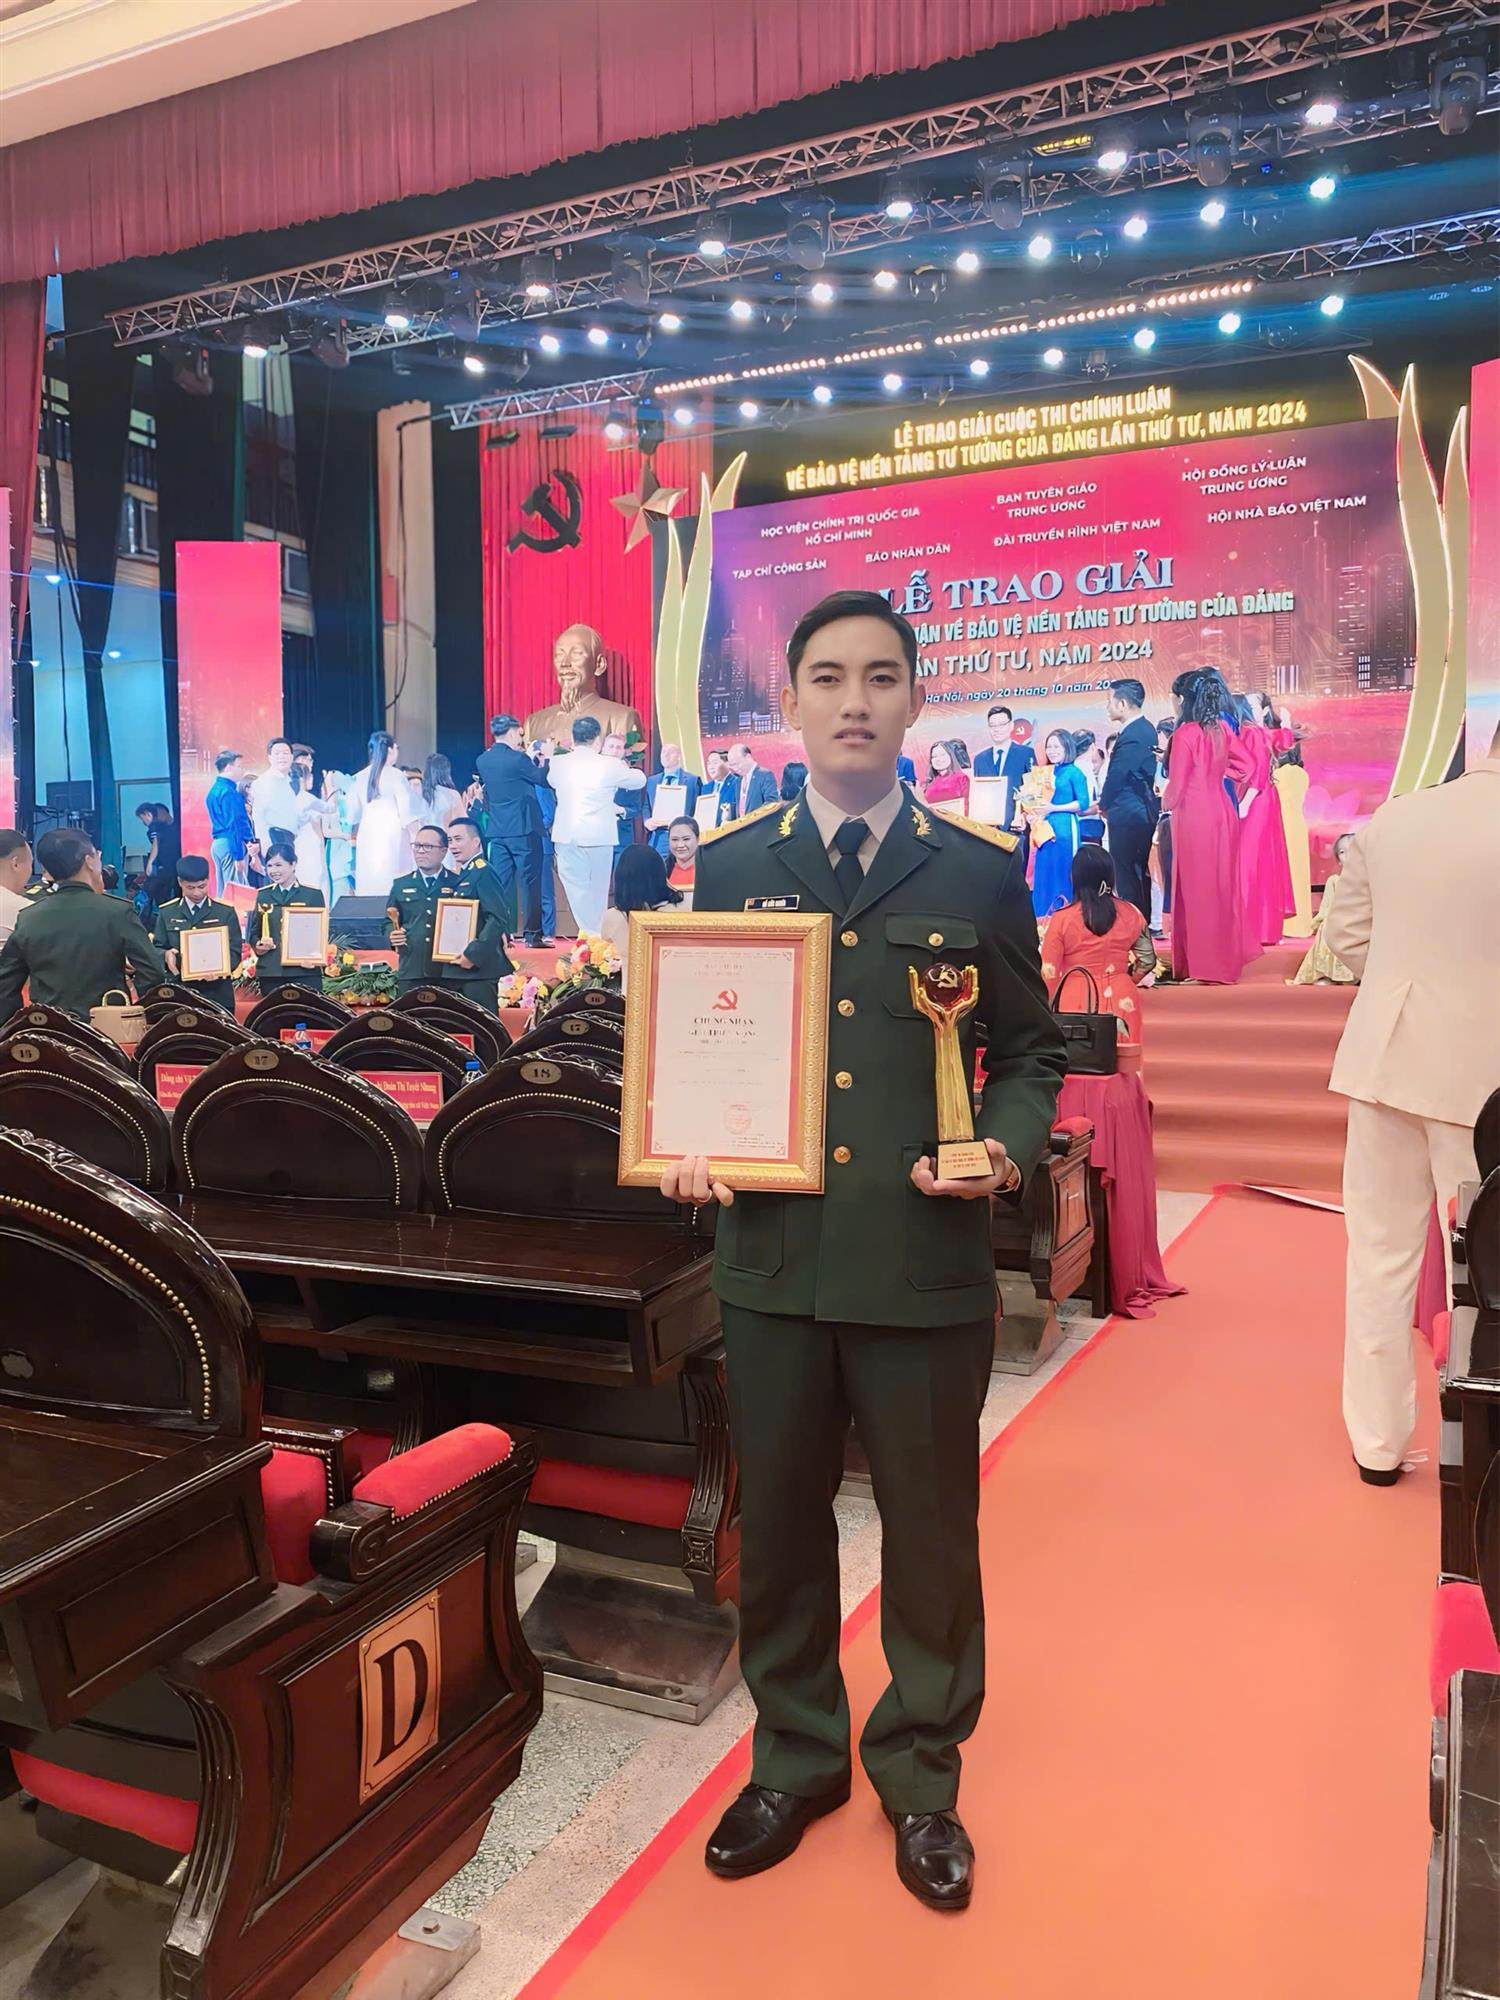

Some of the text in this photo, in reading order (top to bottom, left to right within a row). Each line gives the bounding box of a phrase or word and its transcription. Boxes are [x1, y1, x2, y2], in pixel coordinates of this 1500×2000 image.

[916, 420, 957, 447] TRAO
[959, 410, 991, 440] GIẢI
[995, 406, 1036, 435] CUỘC
[1040, 407, 1066, 428] THI
[1070, 396, 1124, 425] CHÍNH
[1126, 385, 1171, 417] LUẬN
[806, 459, 837, 487] BẢO
[839, 457, 859, 485] VỆ
[894, 447, 935, 474] TẢNG
[936, 446, 959, 469] TƯ
[960, 435, 1012, 465] TƯỞNG
[1015, 433, 1049, 458] CỦA
[1052, 425, 1098, 455] ĐẢNG
[1138, 413, 1175, 443] THỨ
[1208, 405, 1253, 434] NĂM
[1256, 400, 1307, 428] 2024
[1182, 467, 1205, 482] HỘI
[1251, 459, 1268, 473] LÝ
[1269, 455, 1307, 471] LUẬN
[996, 481, 1098, 505] BAN TUYÊN GIÁO
[1200, 475, 1288, 495] TRUNG ƯƠNG
[761, 506, 920, 539] HỌC VIỆN CHÍNH TRỊ QUỐC GIA
[1007, 499, 1086, 518] TRUNG ƯƠNG
[1207, 495, 1367, 525] HỘI NHÀ BÁO VIỆT NAM
[823, 530, 842, 543] CHÍ
[844, 528, 873, 541] MINH
[993, 533, 1015, 547] ĐÀI
[1067, 523, 1098, 538] HÌNH
[1100, 520, 1128, 535] VIỆT
[1131, 518, 1161, 531] NAM
[865, 543, 951, 564] BÁO NHÂN DÂN
[732, 557, 827, 581] TẠP CHÍ CỘNG SẢN
[942, 570, 1064, 610] TRAO
[1075, 549, 1175, 596] GIẢI
[967, 614, 998, 639] BẢO
[1003, 613, 1023, 640] VỆ
[1027, 608, 1060, 633] NỀN
[1065, 604, 1109, 630] TẢNG
[1113, 603, 1137, 626] TƯ
[1138, 596, 1197, 623] TƯỞNG
[1201, 591, 1239, 618] CỦA
[1242, 588, 1295, 615] ĐẢNG
[945, 648, 991, 675] THỨ
[996, 647, 1033, 672] TƯ,
[1039, 641, 1091, 667] NĂM
[1099, 639, 1153, 662] 2024
[997, 688, 1010, 698] 20
[1052, 684, 1063, 693] 10
[533, 1068, 550, 1078] 18
[373, 1639, 428, 1768] D
